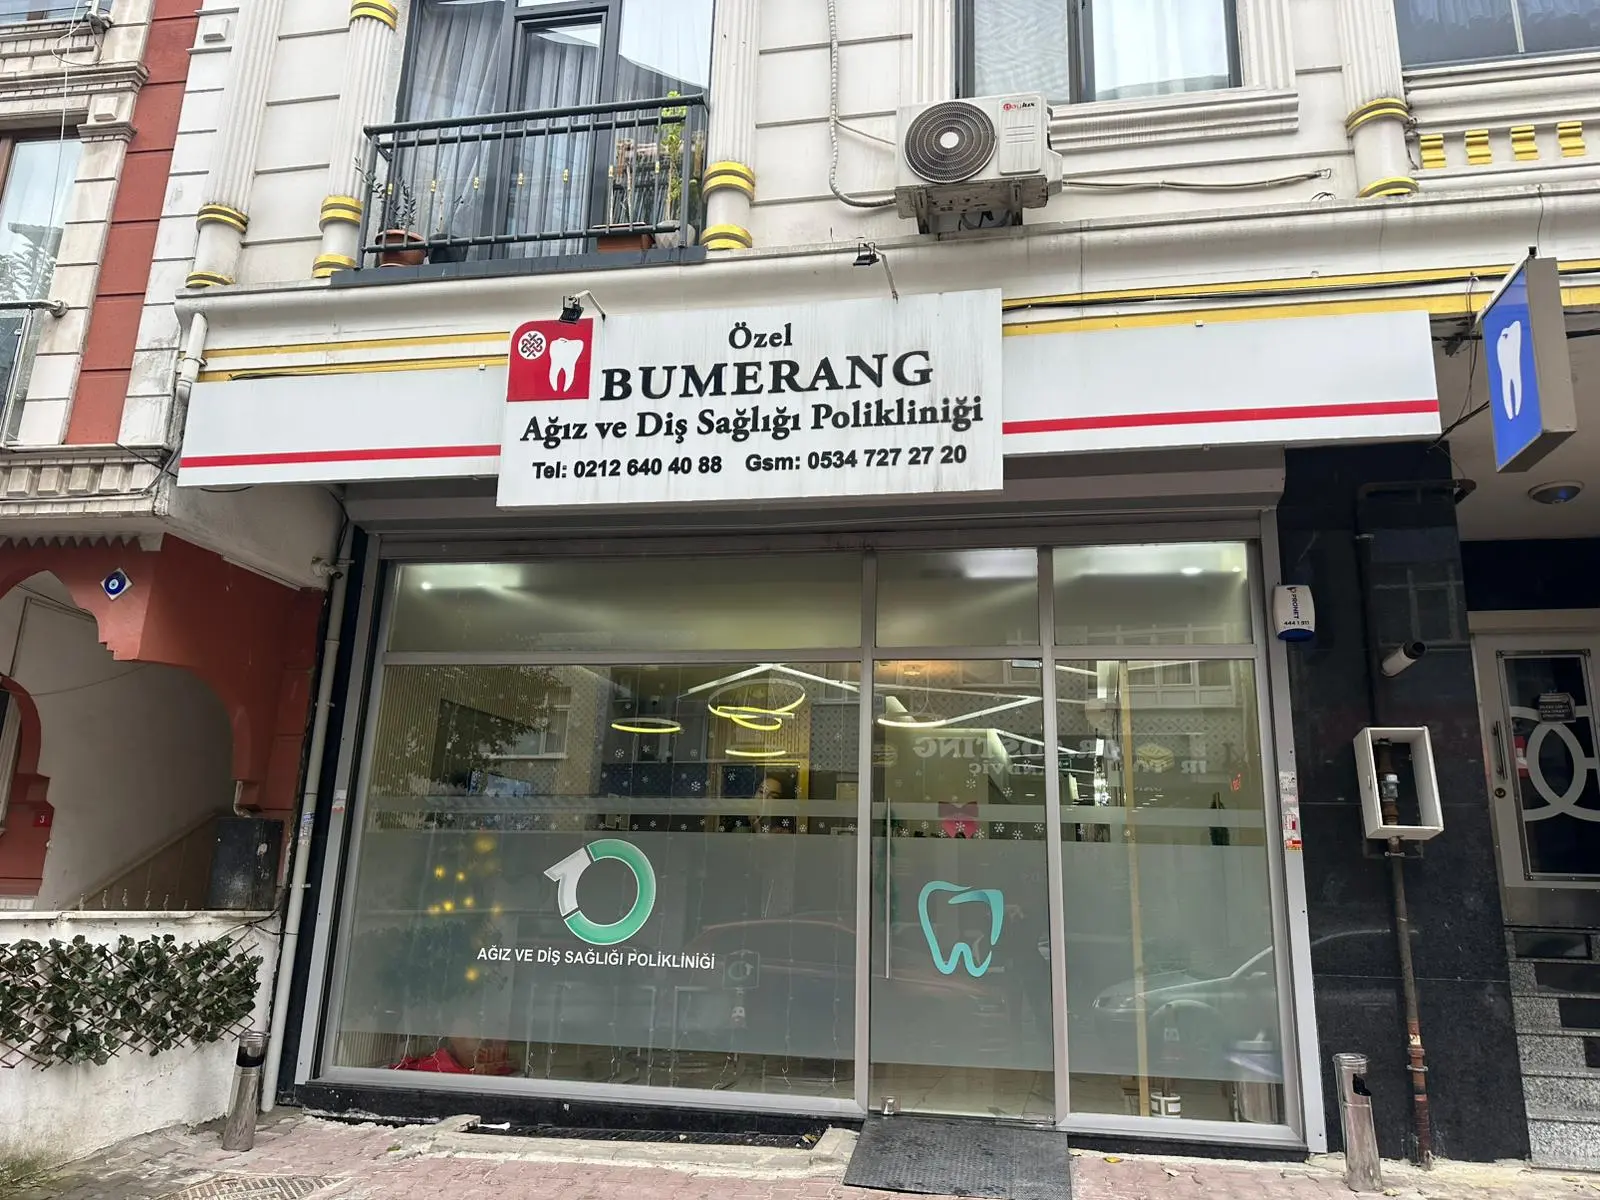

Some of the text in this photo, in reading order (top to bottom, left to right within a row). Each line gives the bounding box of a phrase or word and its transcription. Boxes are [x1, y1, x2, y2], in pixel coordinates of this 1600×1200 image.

[728, 322, 792, 349] Özel
[600, 351, 933, 401] BUMERANG
[520, 396, 984, 449] Ağız ve Diş Sağlığı Polikliniği
[532, 444, 967, 480] Tel: 0212 640 40 88 Gsm: 0534 727 27 20
[39, 815, 45, 824] 3
[477, 944, 716, 970] AĞIZ VE DİŞ SAĞLIĞI POLİKLİNİĞİ
